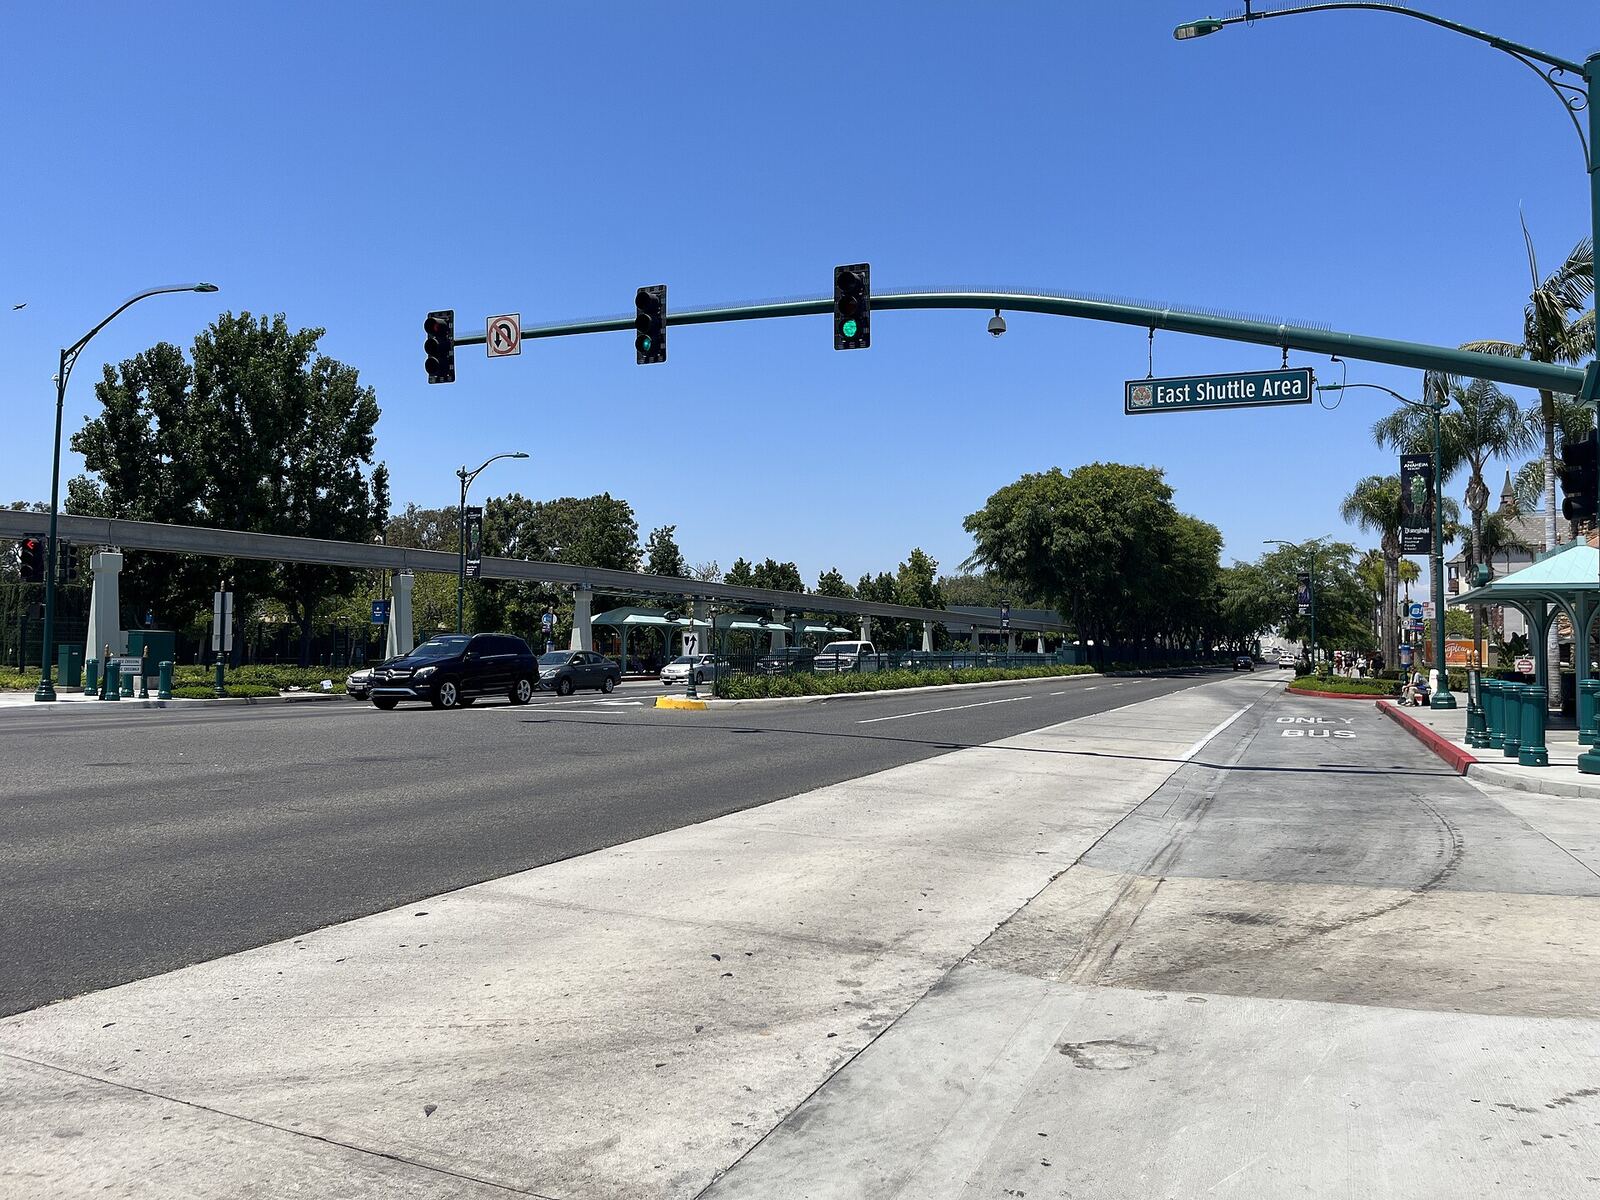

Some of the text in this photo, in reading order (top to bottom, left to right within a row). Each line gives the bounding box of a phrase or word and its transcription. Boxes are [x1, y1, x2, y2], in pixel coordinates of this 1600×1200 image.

[1157, 378, 1302, 404] East Shuttle Area
[1281, 729, 1357, 738] BUS
